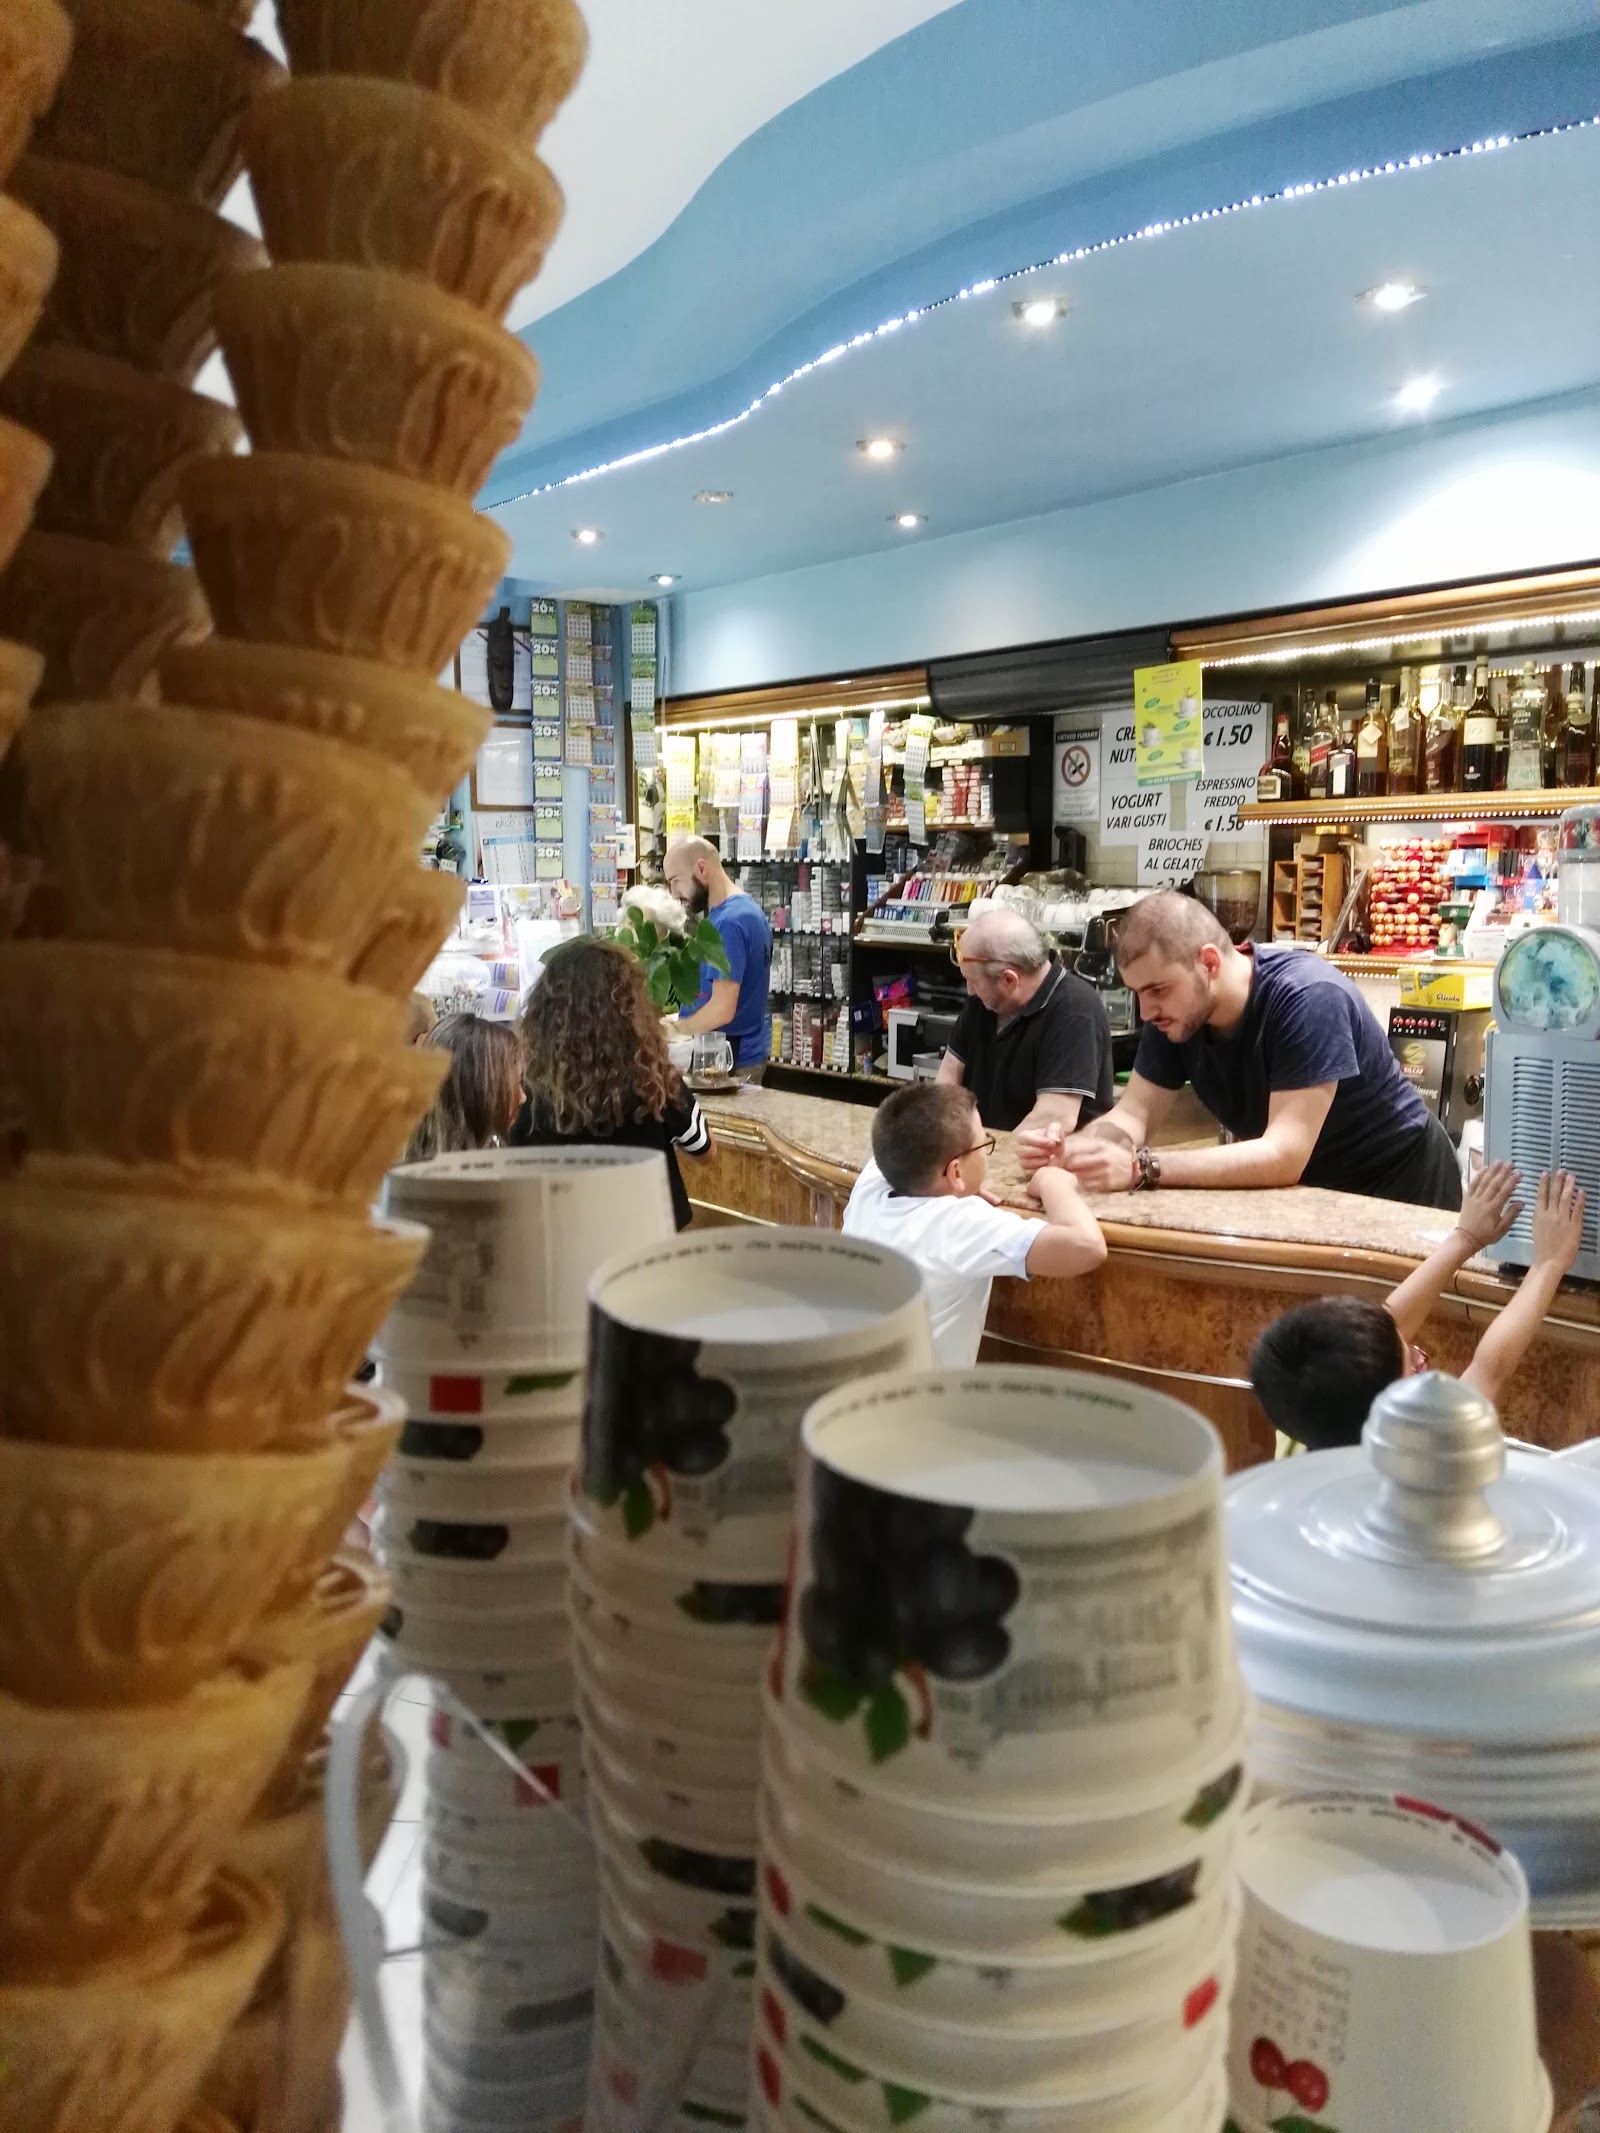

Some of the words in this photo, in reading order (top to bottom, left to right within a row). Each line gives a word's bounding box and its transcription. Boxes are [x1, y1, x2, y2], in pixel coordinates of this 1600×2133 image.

[533, 644, 556, 654] 20x
[534, 685, 558, 695] 20x
[1203, 703, 1261, 719] OCCIOLINO
[534, 726, 559, 736] 20x
[1116, 725, 1136, 742] CRE
[1203, 731, 1214, 746] €
[1215, 723, 1253, 747] 1.50
[1109, 747, 1136, 764] NUT
[536, 766, 560, 777] 20x
[1195, 777, 1256, 791] ESPRESSINO
[1111, 792, 1162, 810] YOGURT
[1204, 794, 1246, 807] FREDDO
[536, 807, 560, 818] 20x
[1107, 815, 1132, 829] VARI
[1133, 813, 1167, 828] GUSTI
[1204, 818, 1213, 831] €
[1148, 838, 1204, 851] BRIOCHES
[537, 848, 560, 858] 20x
[1144, 857, 1159, 870] AL
[1162, 857, 1204, 871] GELATO
[1416, 1085, 1438, 1099] inseng
